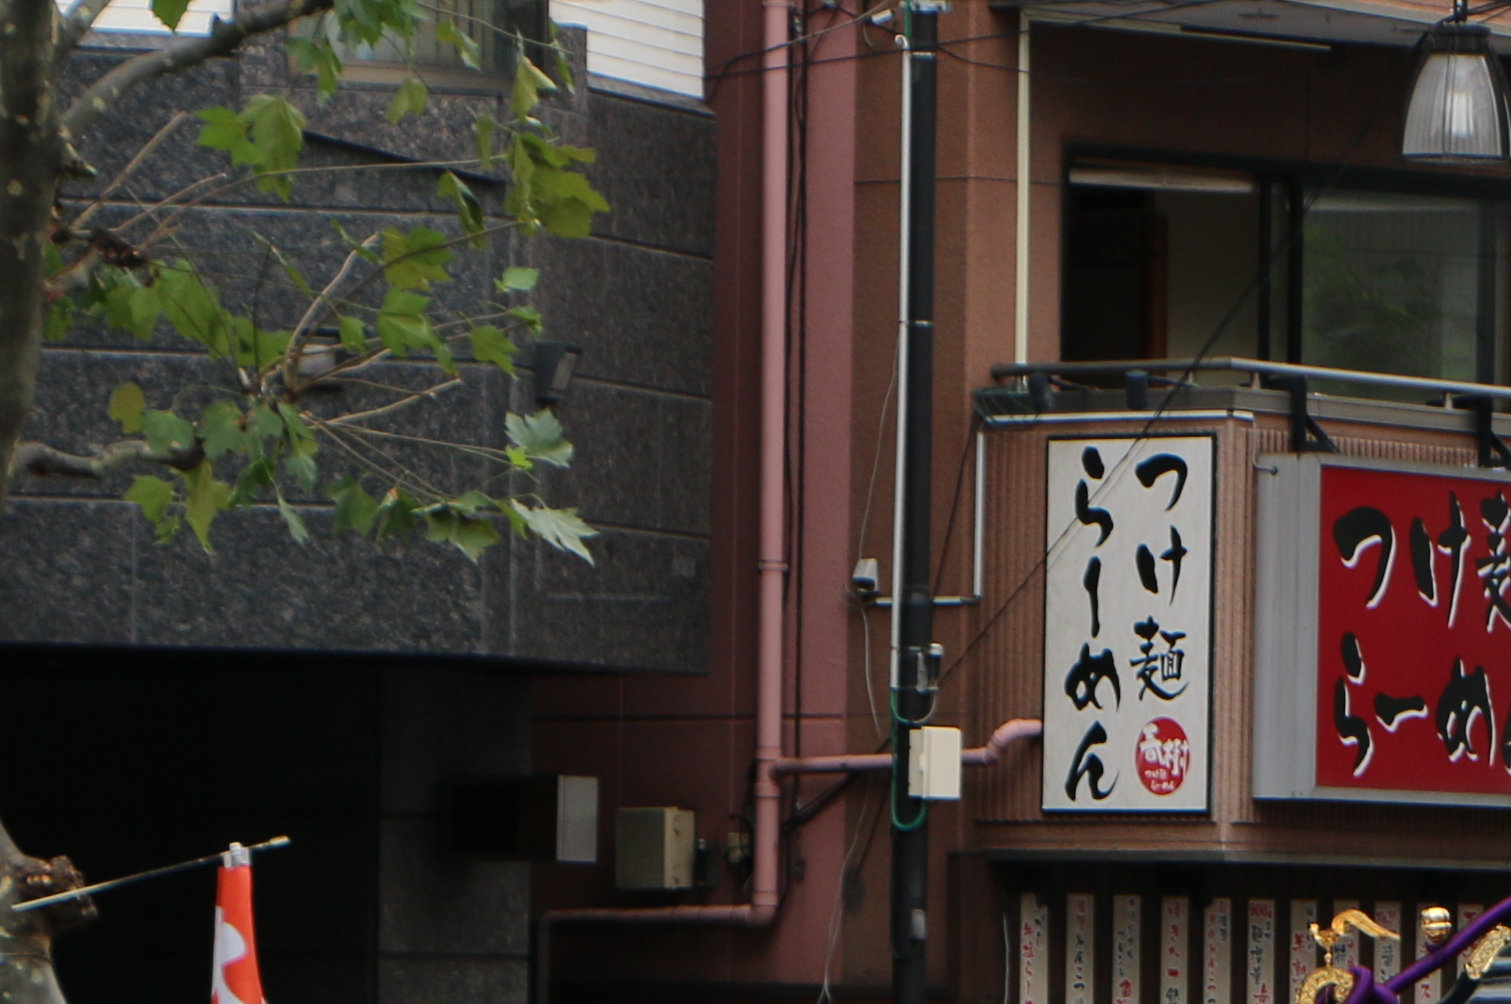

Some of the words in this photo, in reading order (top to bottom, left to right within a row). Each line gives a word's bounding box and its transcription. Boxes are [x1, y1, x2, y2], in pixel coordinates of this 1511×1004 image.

[1065, 446, 1121, 801] らーめん
[1130, 453, 1188, 701] つけ麺
